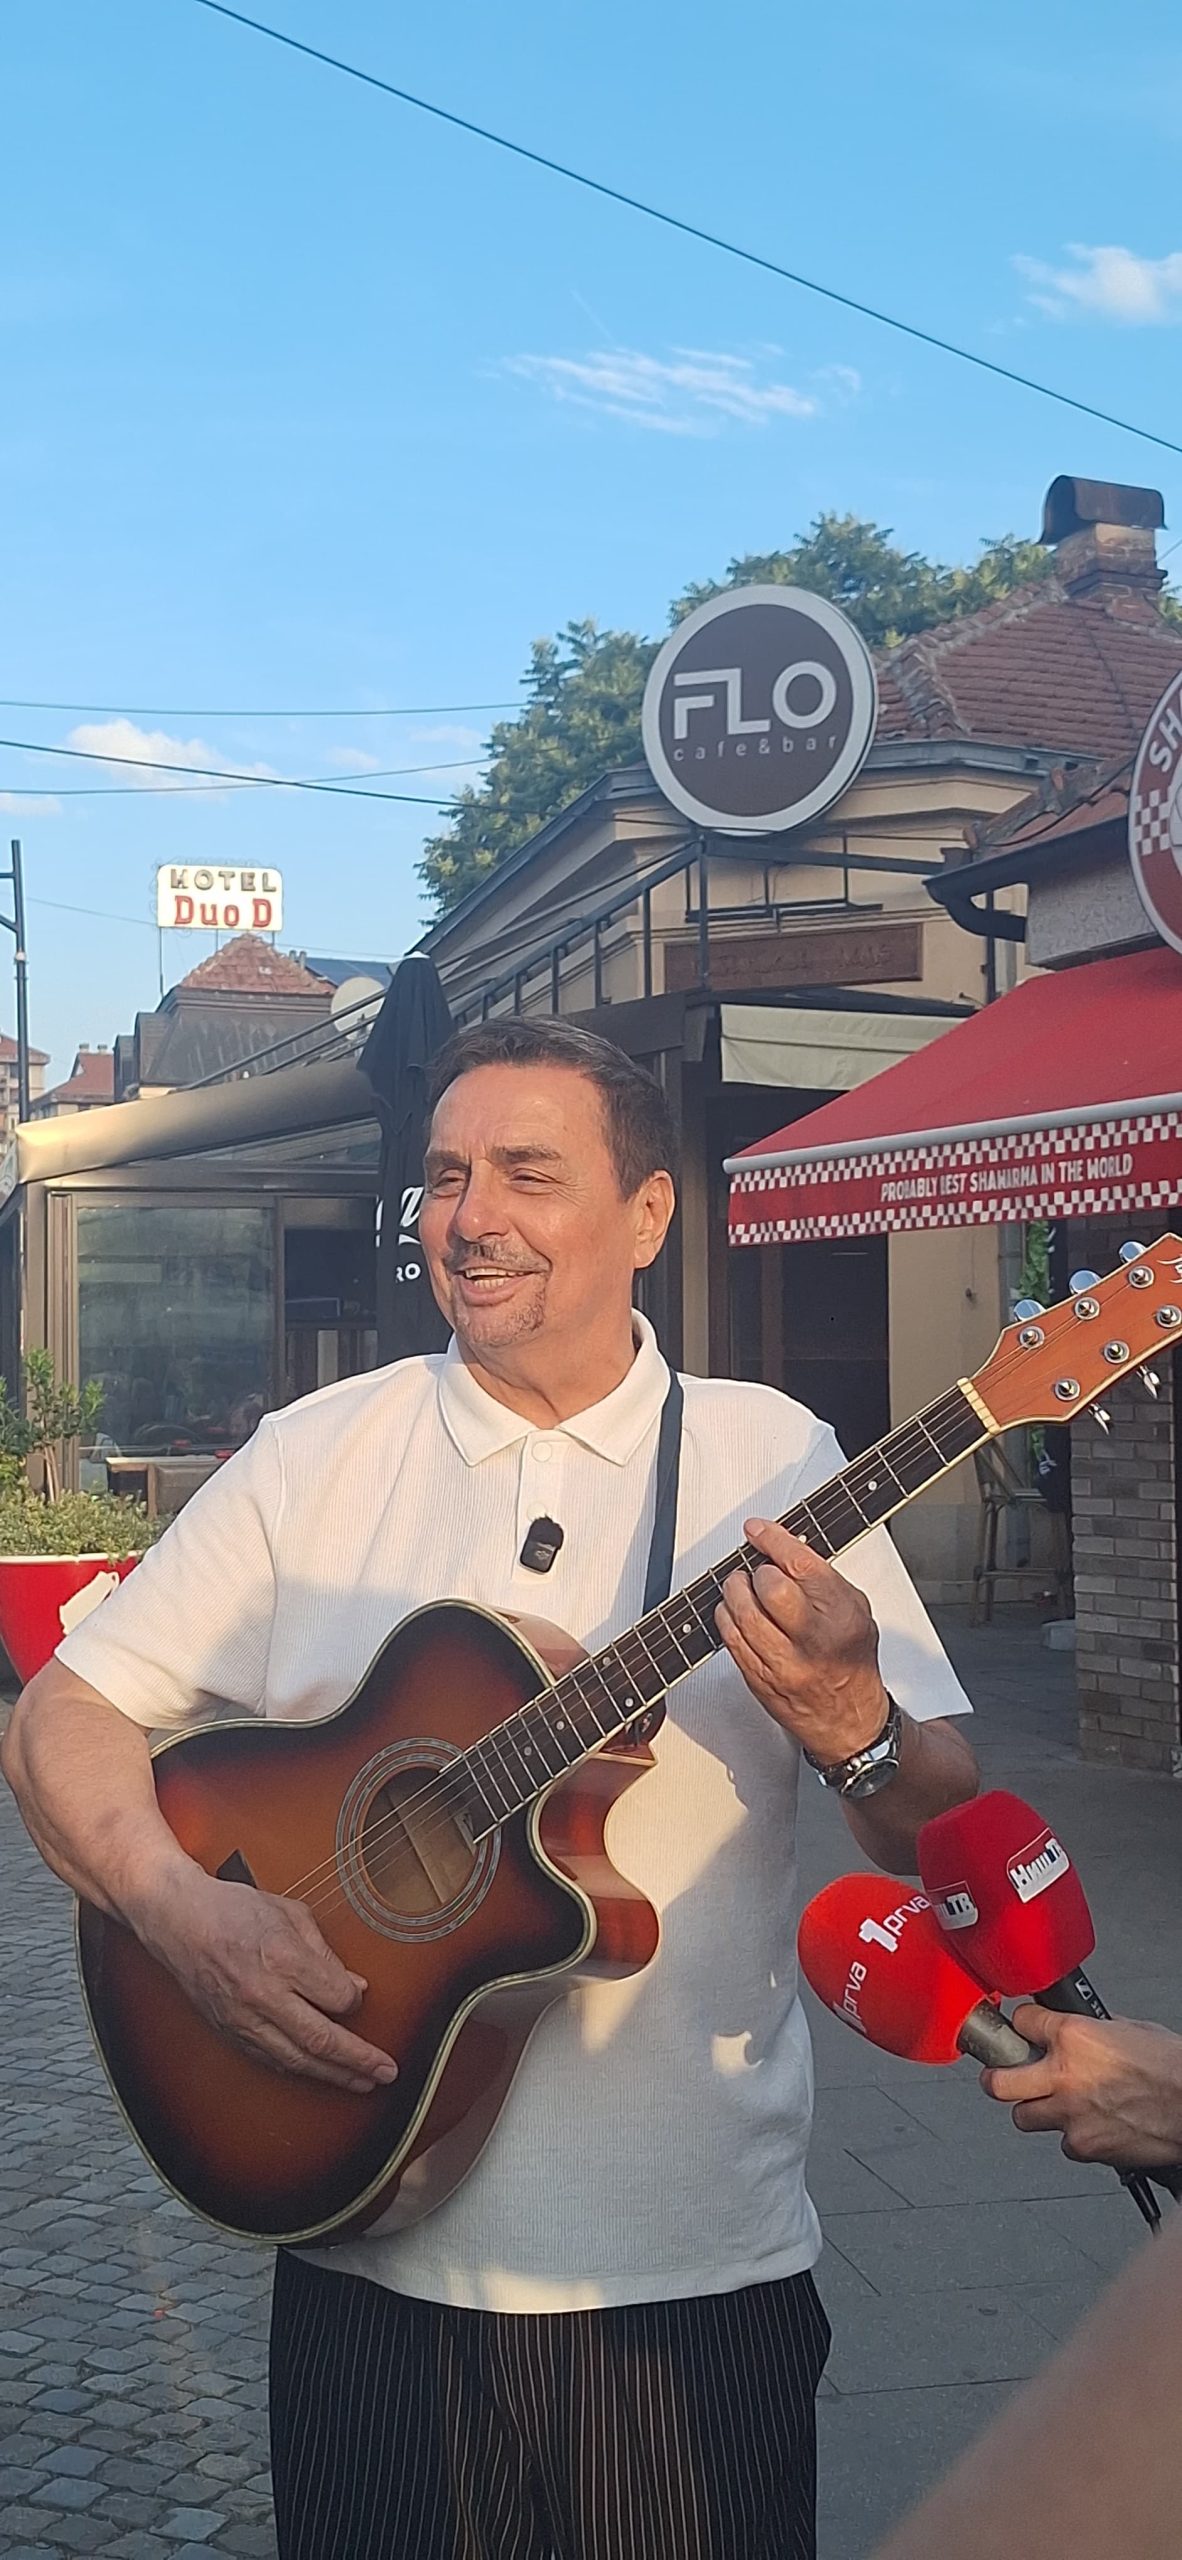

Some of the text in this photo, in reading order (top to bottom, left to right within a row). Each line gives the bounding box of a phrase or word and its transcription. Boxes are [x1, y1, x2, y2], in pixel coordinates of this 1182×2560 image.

[673, 661, 837, 740] FLO
[1149, 688, 1182, 772] SH
[170, 868, 277, 892] HOTEL
[174, 895, 272, 927] Duo D
[1041, 1161, 1055, 1185] IN
[1058, 1159, 1084, 1184] THE
[1086, 1152, 1133, 1180] WORLD
[396, 1262, 421, 1282] RO
